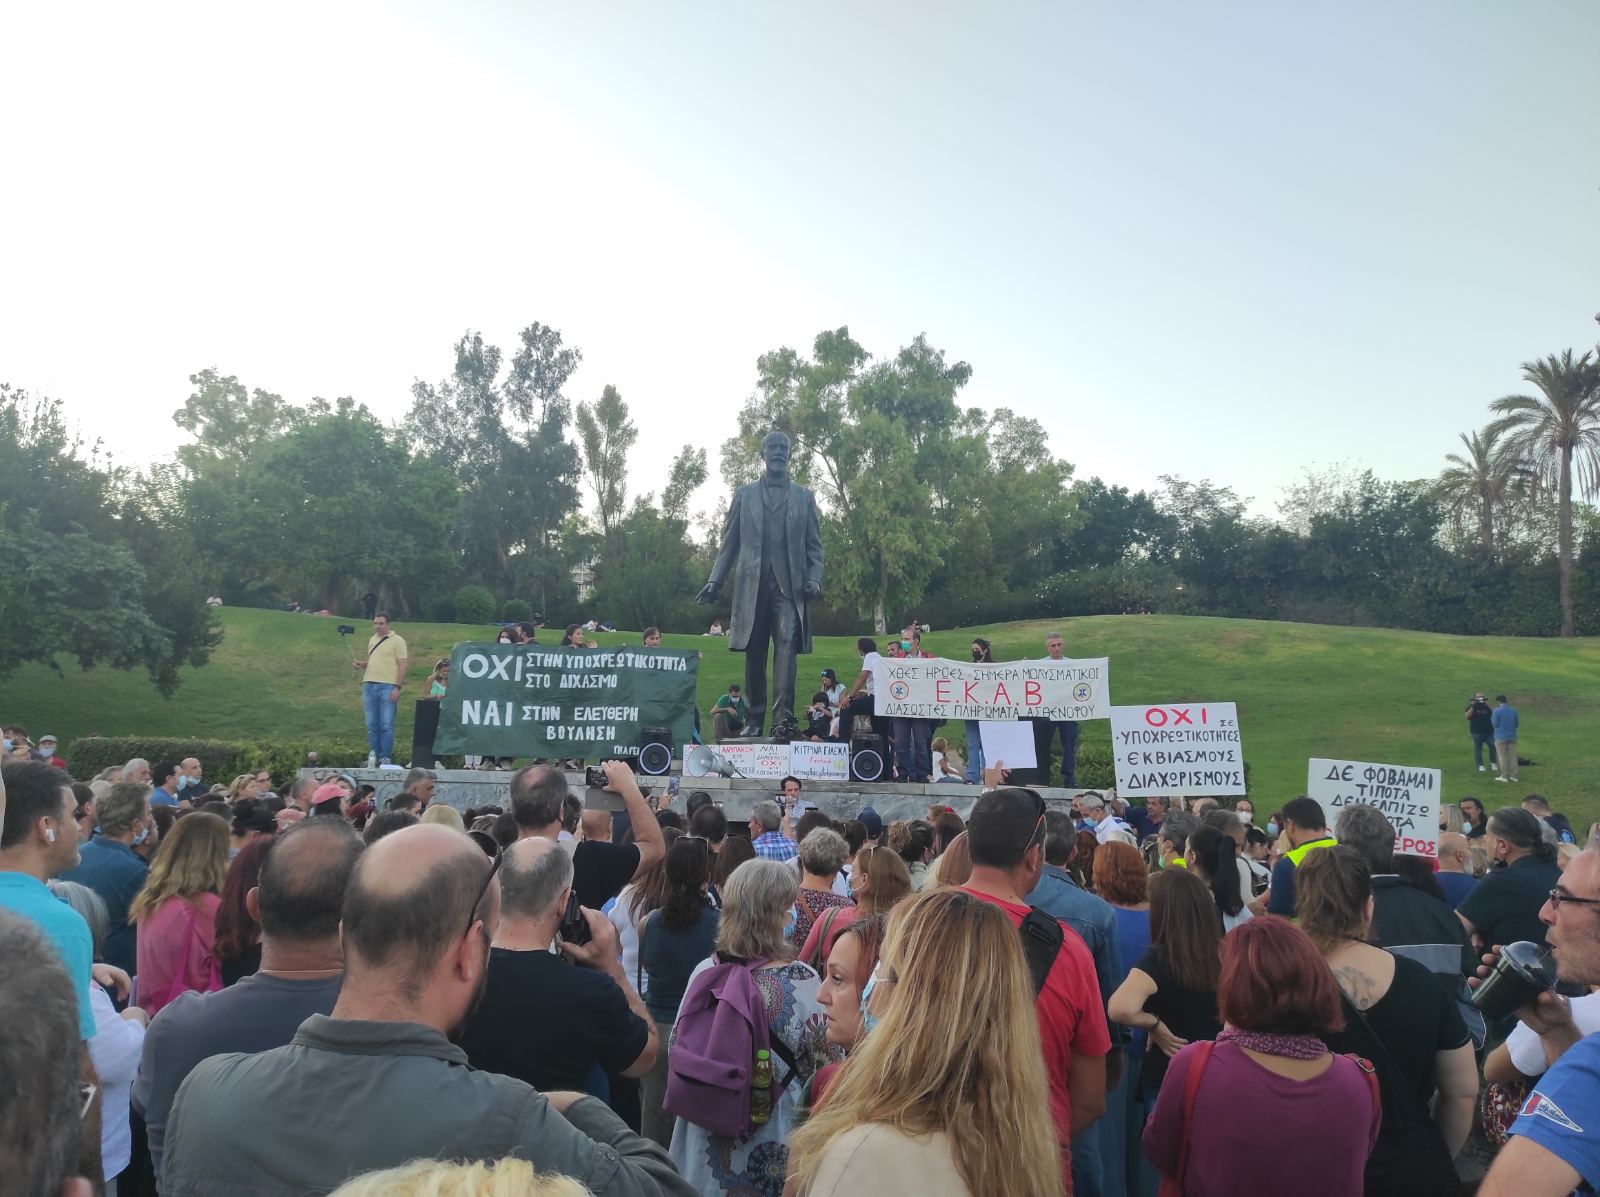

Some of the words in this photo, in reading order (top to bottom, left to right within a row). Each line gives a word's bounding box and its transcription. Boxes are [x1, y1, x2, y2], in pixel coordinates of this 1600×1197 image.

[463, 653, 522, 681] ΟΧΙ
[526, 652, 563, 668] ΣΤΗΝ
[566, 652, 687, 671] ΥΠΟΧΡΕΩΤΙΚΟΤΗΤΑ
[888, 667, 919, 680] ΧΘΕΣ
[926, 666, 964, 681] ΗΡΩΕΣ
[973, 668, 1020, 681] ΣΗΜΕΡΑ
[1022, 667, 1099, 681] ΜΟΛΥΣΜΑΤΙΚΟΙ
[525, 673, 551, 688] ΣΤΟ
[560, 673, 618, 688] ΔΙΧΑΣΜΟ
[462, 699, 513, 727] ΝΑΙ
[521, 705, 561, 721] ΣΤΗΝ
[574, 706, 639, 721] ΕΛΕΥΘΕΡΗ
[885, 703, 948, 716] ΔΙΑΣΩΣΤΕΣ
[954, 704, 1020, 718] ΠΛΗΡΩΜΑΤΑ
[1145, 707, 1207, 728] ΟΧΙ
[1219, 719, 1236, 727] ΣΕ
[546, 725, 616, 741] ΒΟΥΛΗΣΗ
[1120, 730, 1240, 745] ΥΠΟΧΡΕΩΤΙΚΟΤΗΤΕΣ
[1127, 750, 1236, 766] ΕΚΒΙΑΣΜΟΥΣ
[1127, 771, 1242, 789] ΔΙΑΧΩΡΙΣΜΟΥΣ
[1325, 765, 1354, 781] ΔΕ
[1363, 766, 1433, 790] ΦΟΒΑΜΑΙ
[1355, 783, 1411, 801] ΤΙΠΟΤΑ
